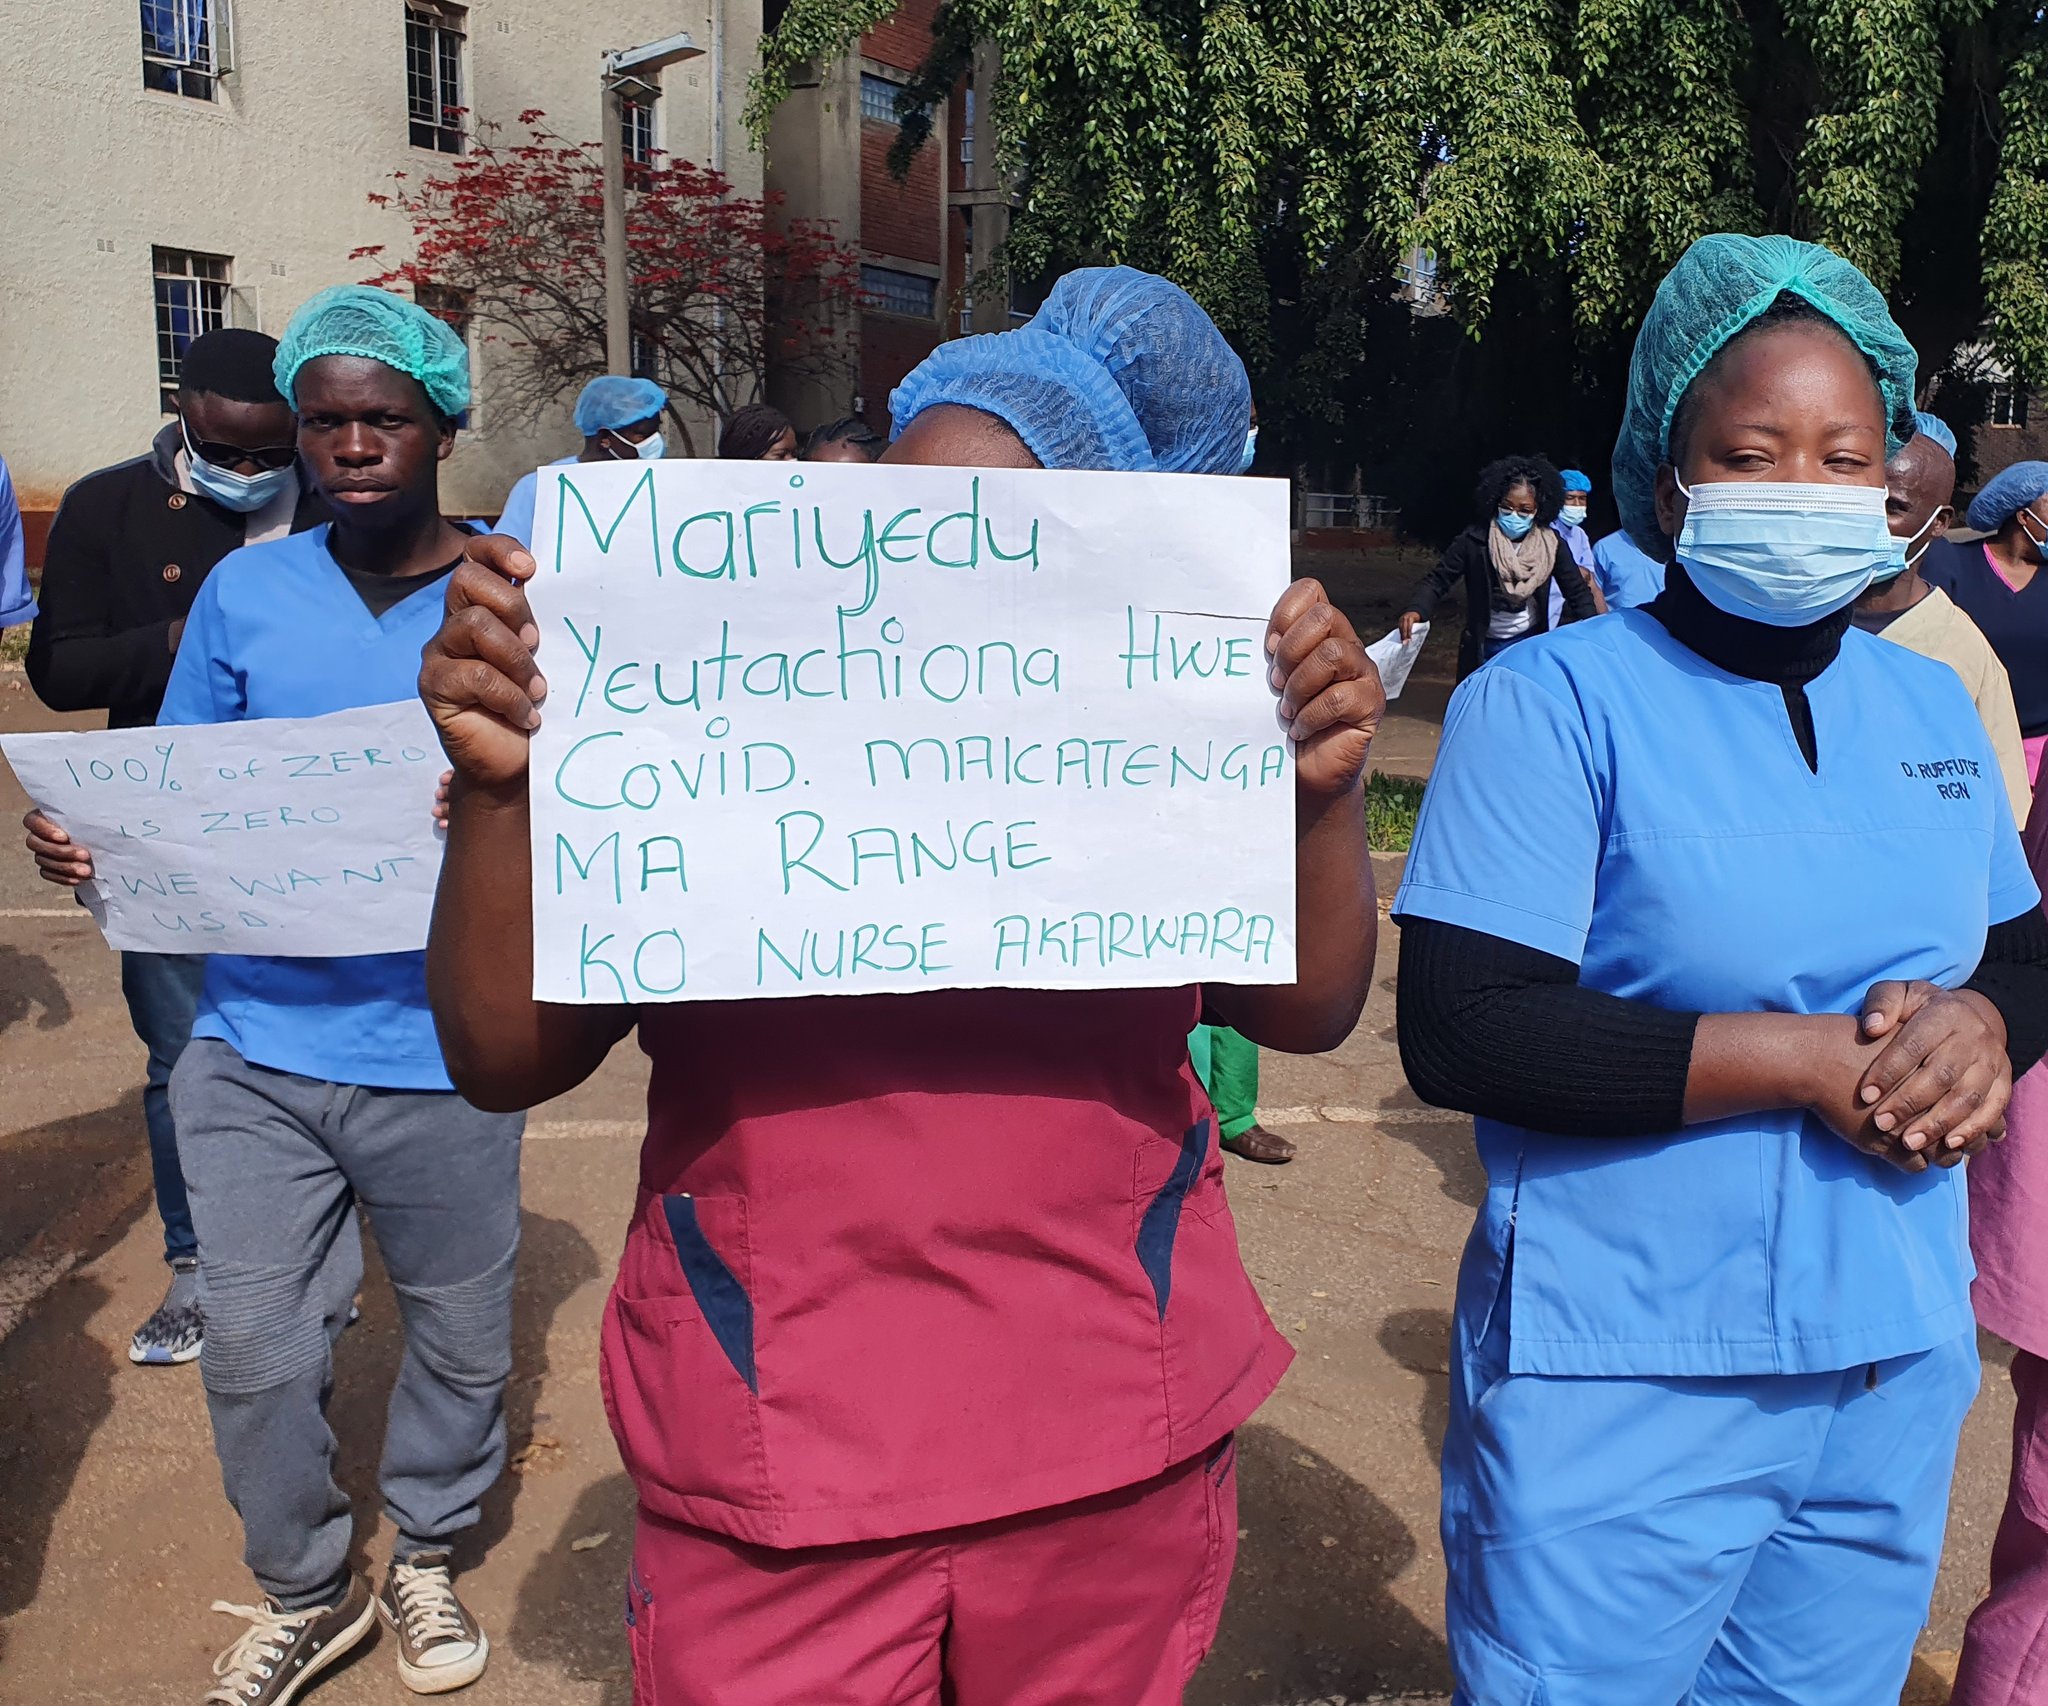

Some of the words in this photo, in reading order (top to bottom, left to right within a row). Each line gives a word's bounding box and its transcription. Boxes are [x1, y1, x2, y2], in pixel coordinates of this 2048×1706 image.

[555, 468, 1038, 618] Mariyedu
[563, 604, 1060, 719] Yeutachiona
[64, 741, 182, 791] 100%
[281, 745, 427, 778] ZERO
[1900, 761, 1918, 779] D.
[1936, 781, 1971, 800] RGN
[200, 806, 341, 834] ZERO
[121, 871, 199, 897] WE
[229, 857, 415, 897] WANT
[555, 832, 688, 904] MA
[775, 810, 1052, 894] RANGE
[580, 924, 687, 1002] KO
[757, 922, 953, 986] NURSE
[992, 906, 1275, 972] AKARWARA
